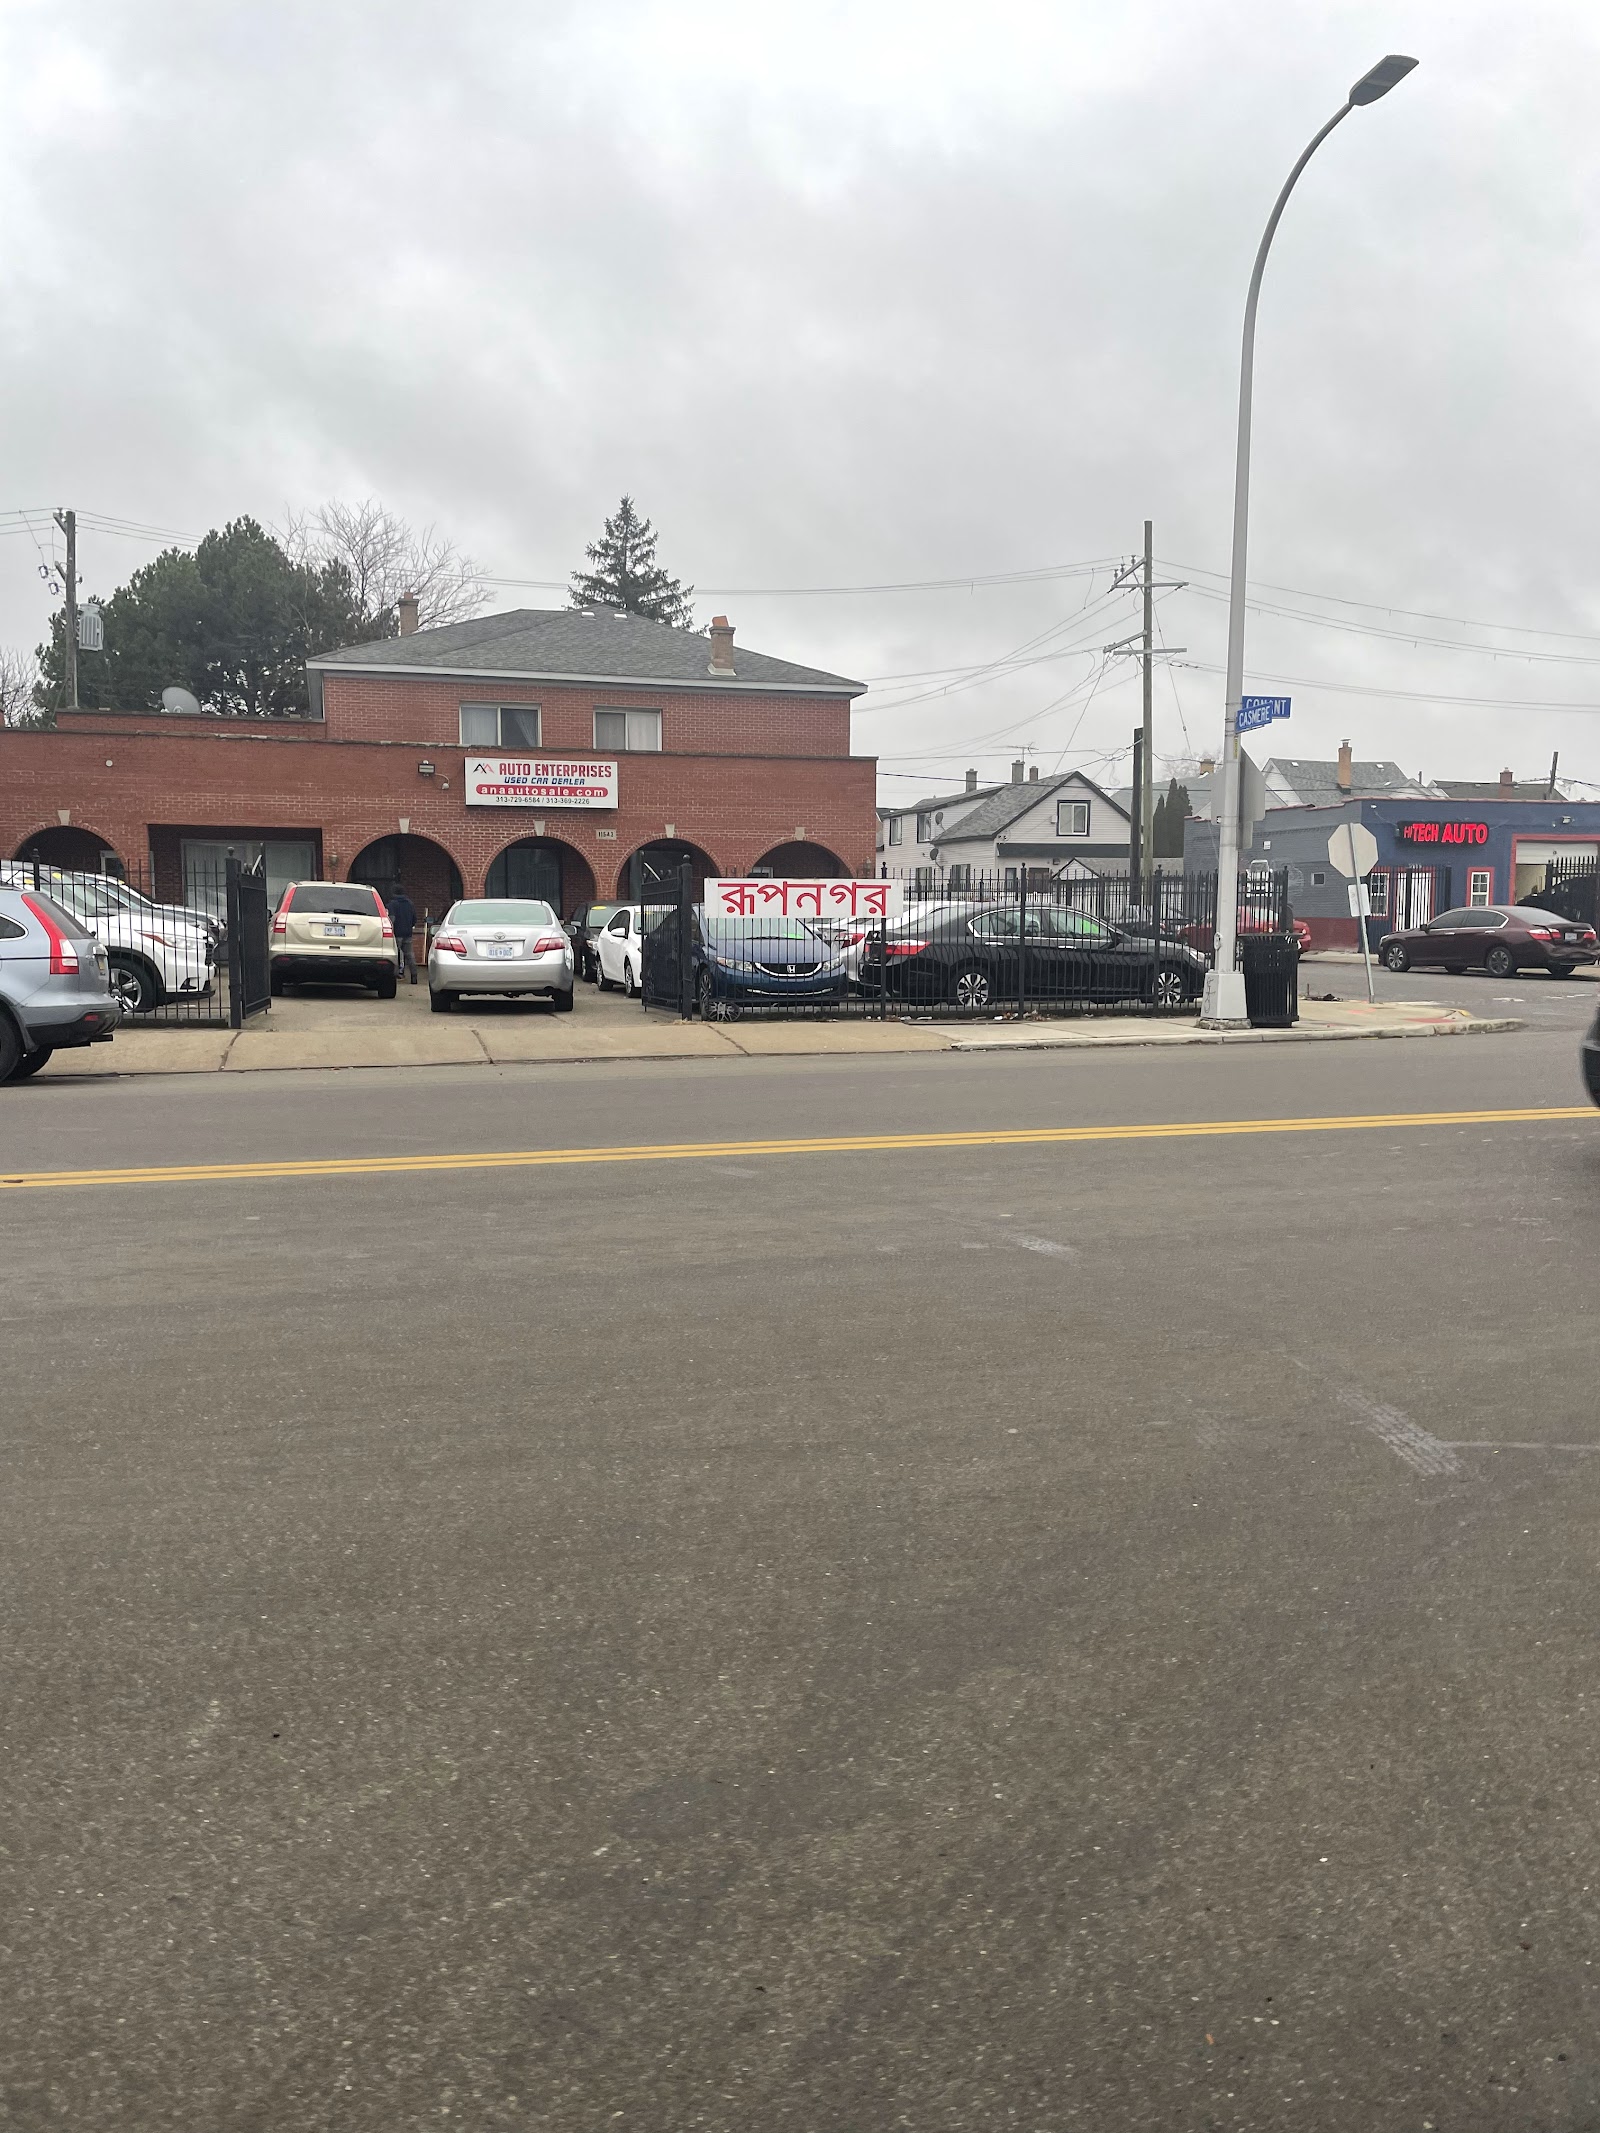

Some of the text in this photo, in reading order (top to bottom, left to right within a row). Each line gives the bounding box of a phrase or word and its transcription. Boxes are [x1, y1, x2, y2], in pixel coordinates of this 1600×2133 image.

[1238, 705, 1271, 727] CASMERE
[499, 762, 531, 776] AUTO
[535, 763, 612, 778] ENTERPRISES
[504, 776, 586, 786] USED CAR DEALER
[481, 786, 604, 797] anaautosale.com
[1441, 823, 1489, 844] AUTO
[717, 881, 892, 917] রূপনগর
